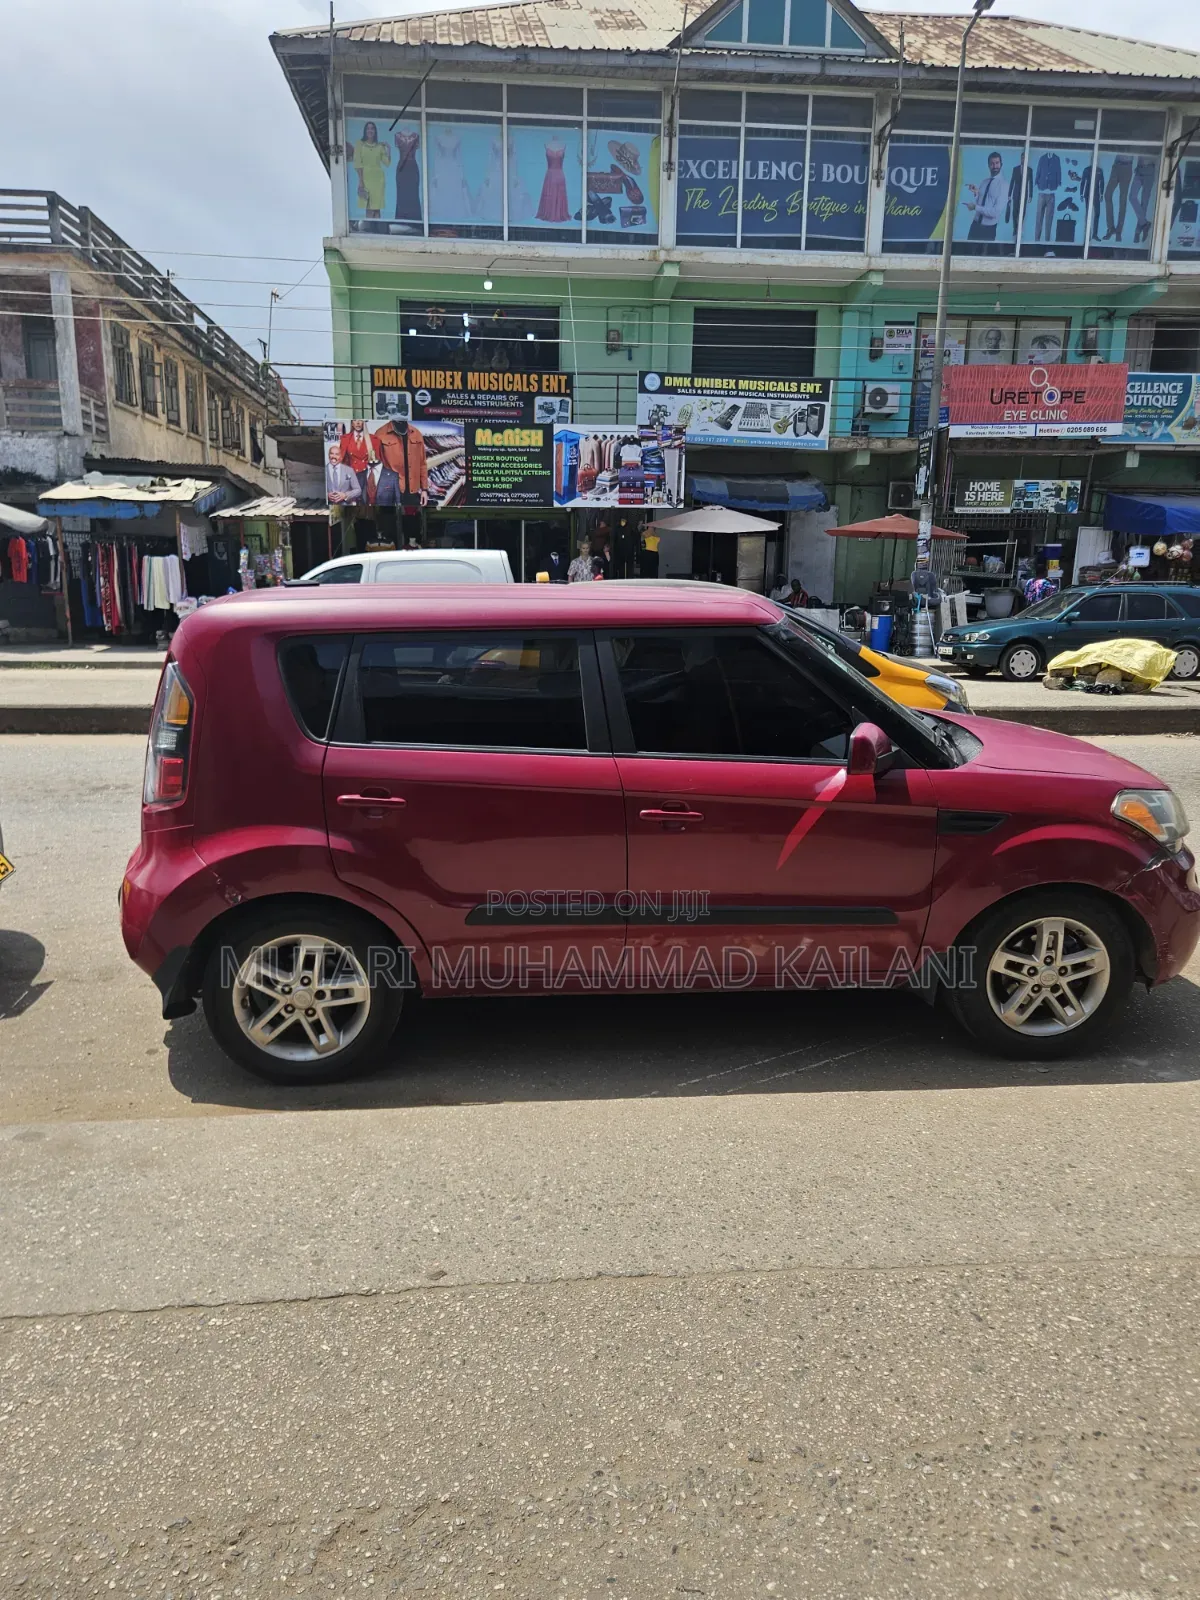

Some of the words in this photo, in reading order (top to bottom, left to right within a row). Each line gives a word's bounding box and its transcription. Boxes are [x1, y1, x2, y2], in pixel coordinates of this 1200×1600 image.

[677, 159, 816, 182] EXCELLENCE
[821, 163, 939, 194] BOUQUE
[685, 188, 712, 213] The
[718, 186, 779, 223] Leading
[786, 190, 850, 222] Boutique
[854, 199, 867, 215] in
[884, 193, 923, 216] hana
[373, 367, 408, 388] DMK
[411, 370, 463, 391] UNIBEX
[467, 372, 538, 393] MUSICALS
[541, 374, 571, 394] ENT.
[664, 376, 692, 388] DMK
[694, 377, 736, 389] UNIBEX
[738, 379, 798, 392] MUSICALS
[800, 382, 823, 394] ENT.
[1124, 382, 1184, 394] CELLENCE
[767, 392, 810, 400] INSTRUMENTS
[989, 386, 1087, 406] URETOPE
[1123, 395, 1178, 408] OUTIQUE
[474, 400, 525, 408] INSTRUMENTS
[1003, 409, 1027, 421] EYE
[1029, 409, 1068, 420] CLINIC
[969, 481, 1001, 492] HOME
[964, 491, 977, 501] IS
[977, 492, 1005, 502] HERE
